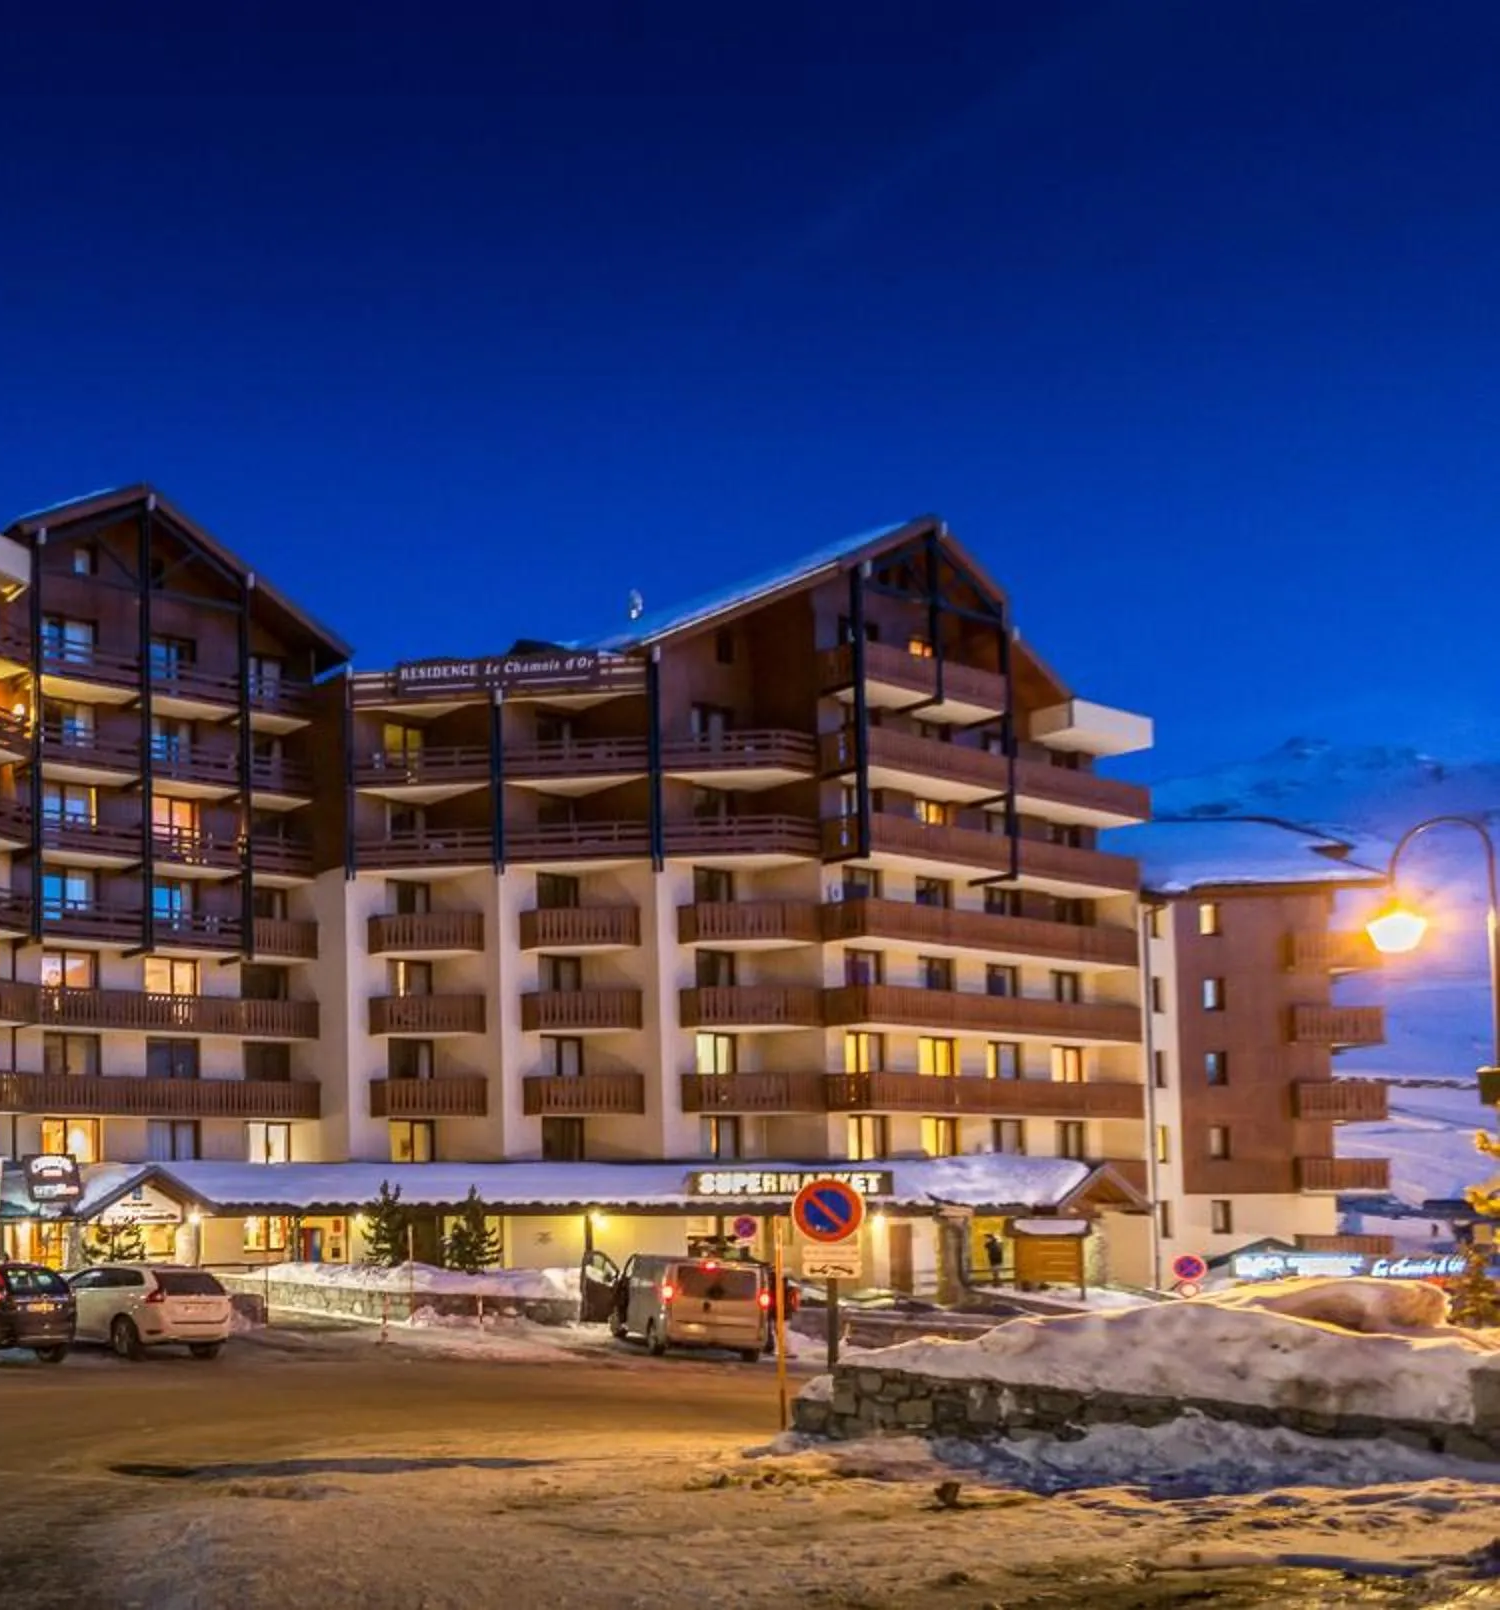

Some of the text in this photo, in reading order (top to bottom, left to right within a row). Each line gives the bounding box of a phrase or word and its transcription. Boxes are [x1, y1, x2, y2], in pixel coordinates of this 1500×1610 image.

[485, 663, 500, 675] Le
[504, 658, 561, 673] Chamois
[698, 1172, 883, 1194] SUPERMAET
